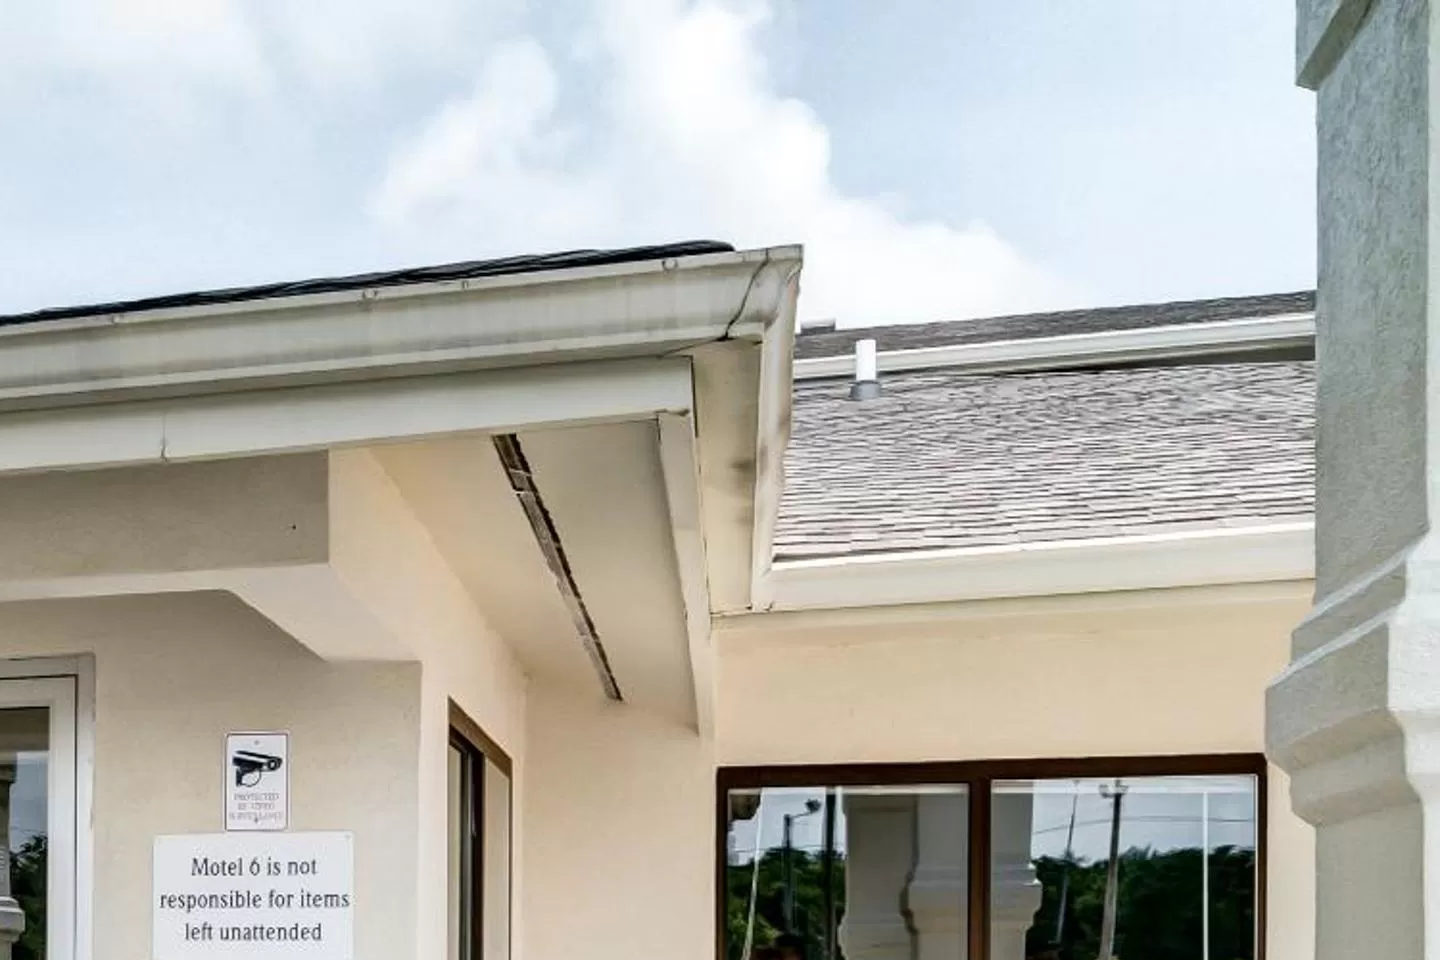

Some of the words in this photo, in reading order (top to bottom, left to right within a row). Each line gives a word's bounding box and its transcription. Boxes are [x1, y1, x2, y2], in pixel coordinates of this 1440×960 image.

[190, 857, 243, 876] Motel
[249, 857, 260, 876] 6
[267, 856, 281, 876] is
[287, 858, 318, 876] not
[160, 889, 262, 913] responsible
[268, 889, 294, 908] for
[300, 889, 350, 908] items
[185, 921, 213, 941] left
[220, 923, 322, 941] unattended
